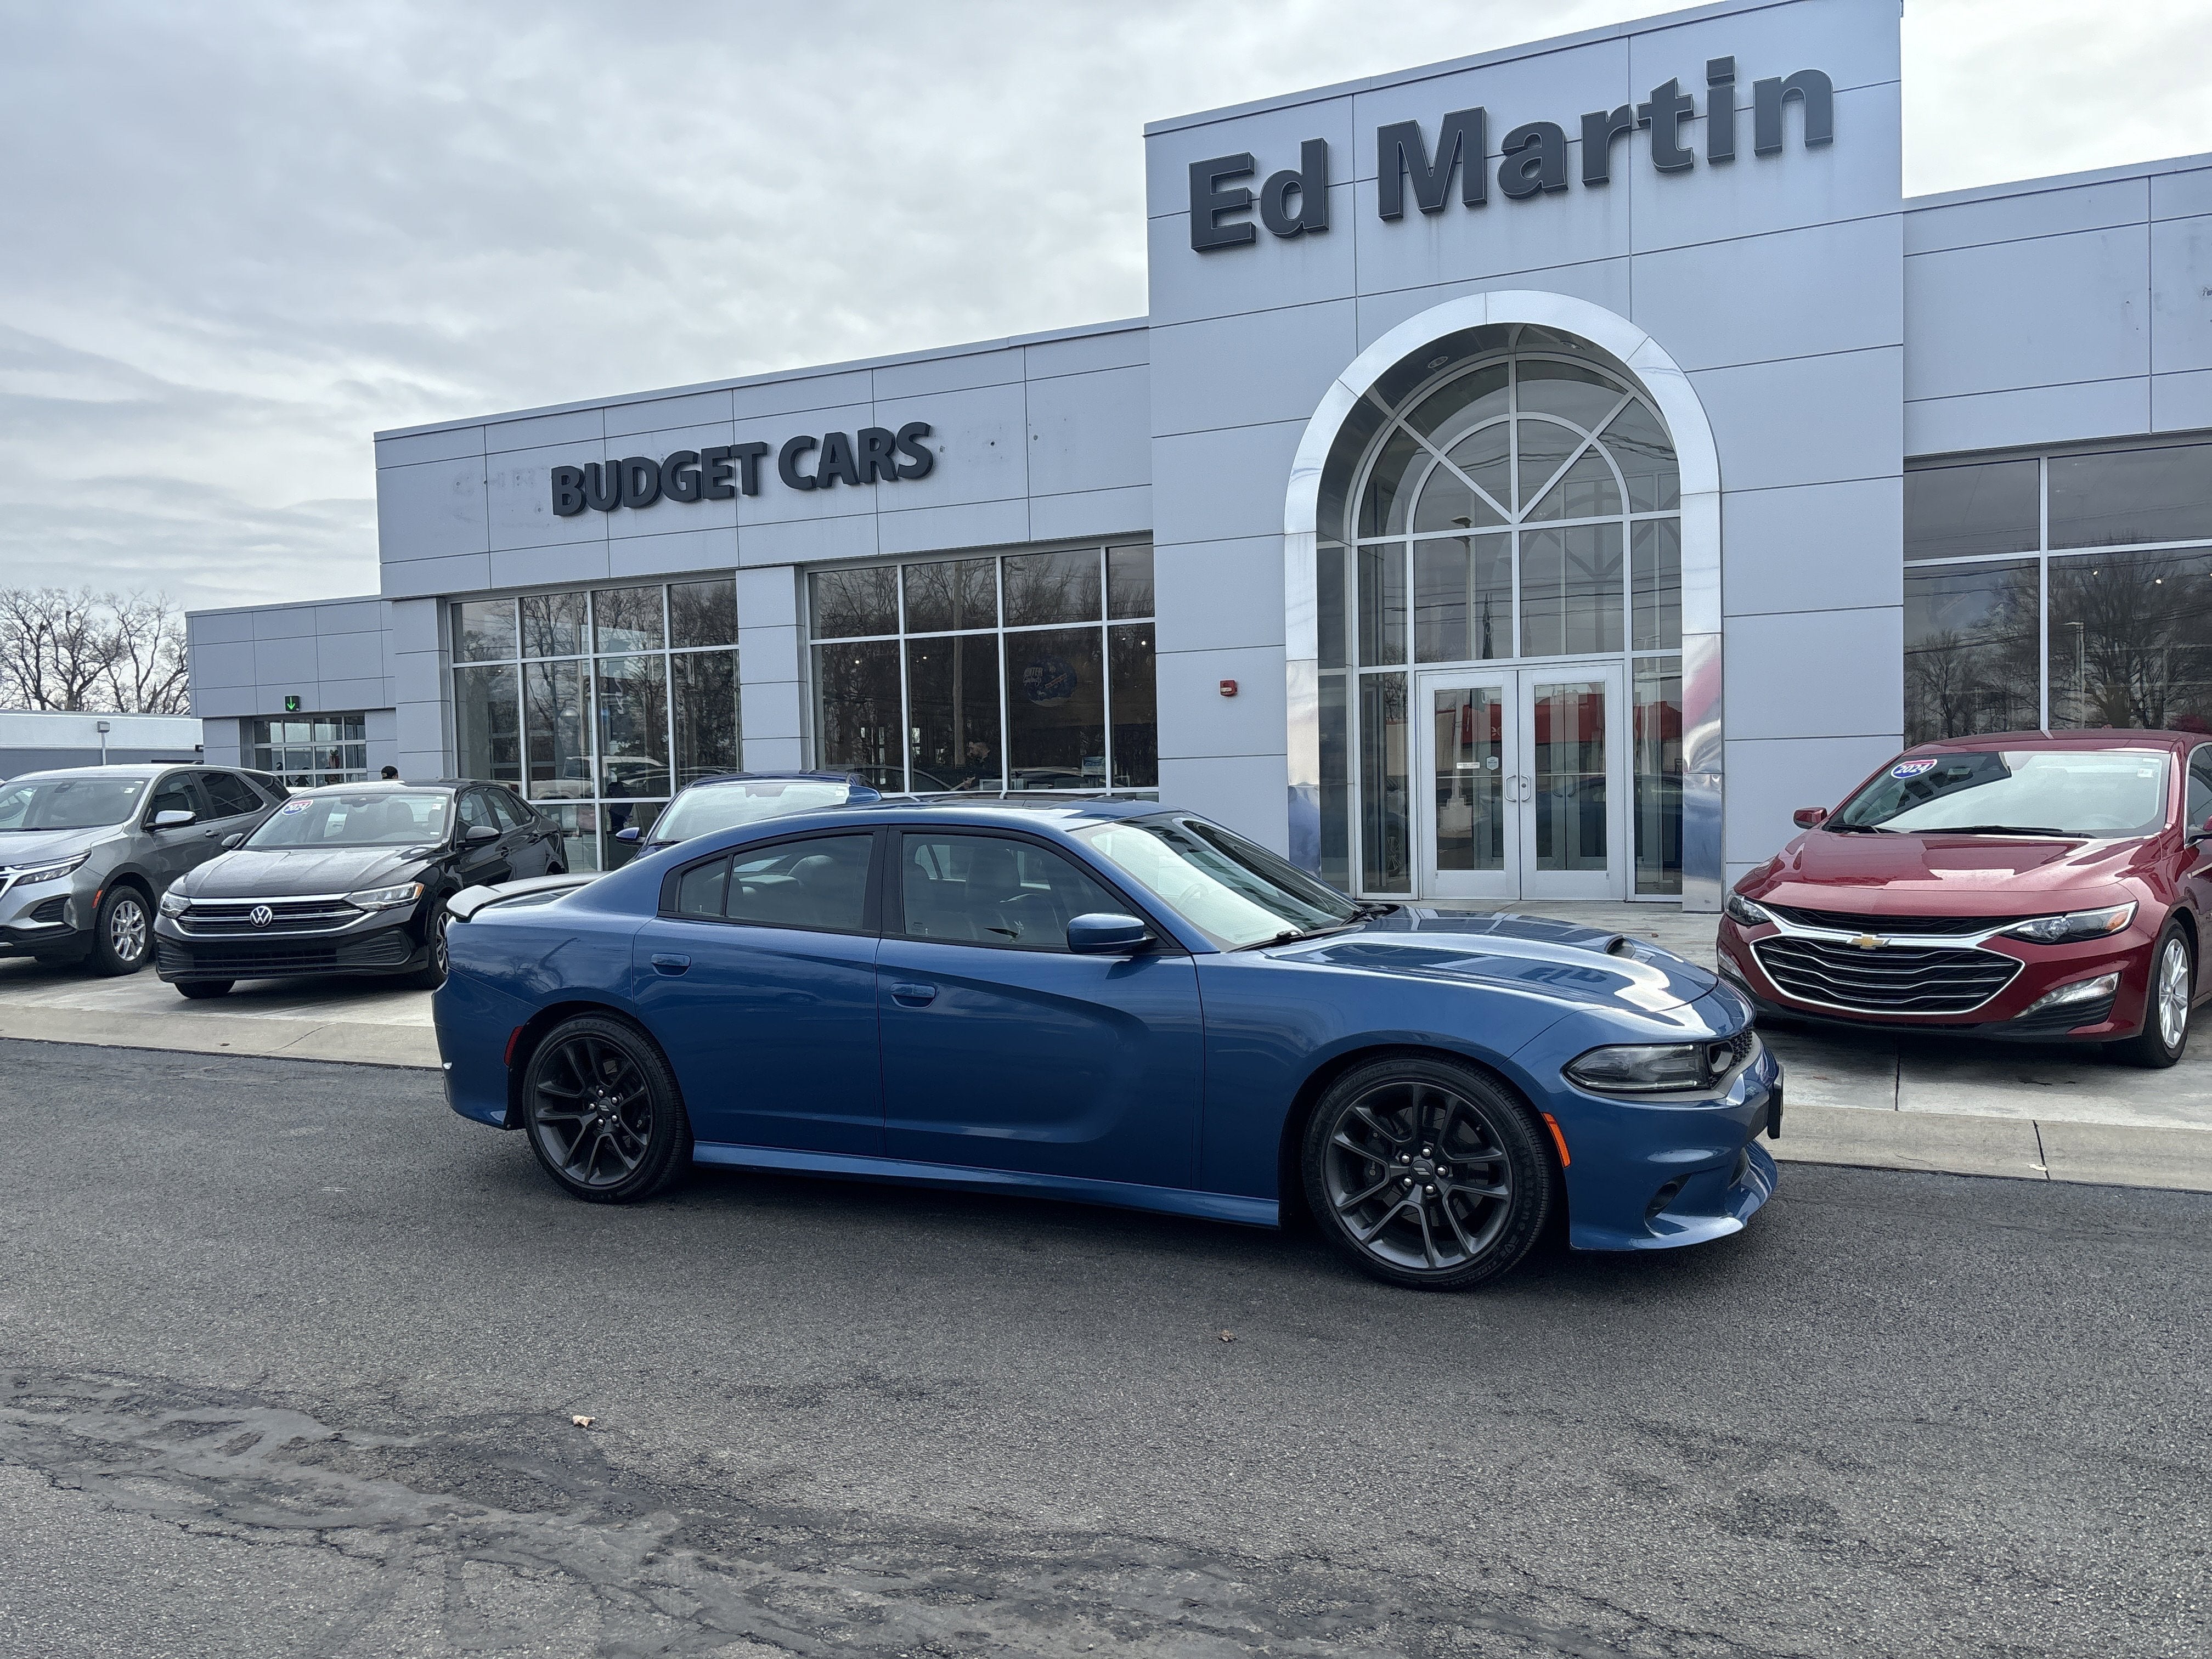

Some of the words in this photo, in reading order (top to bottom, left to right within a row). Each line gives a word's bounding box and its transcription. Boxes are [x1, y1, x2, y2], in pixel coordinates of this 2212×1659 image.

[1189, 137, 1329, 253] Ed
[1376, 55, 1834, 221] Martin
[551, 441, 768, 516] BUDGET
[777, 421, 934, 491] CARS
[1893, 763, 1931, 774] 2024
[284, 803, 308, 812] 2024
[251, 906, 272, 926] VW
